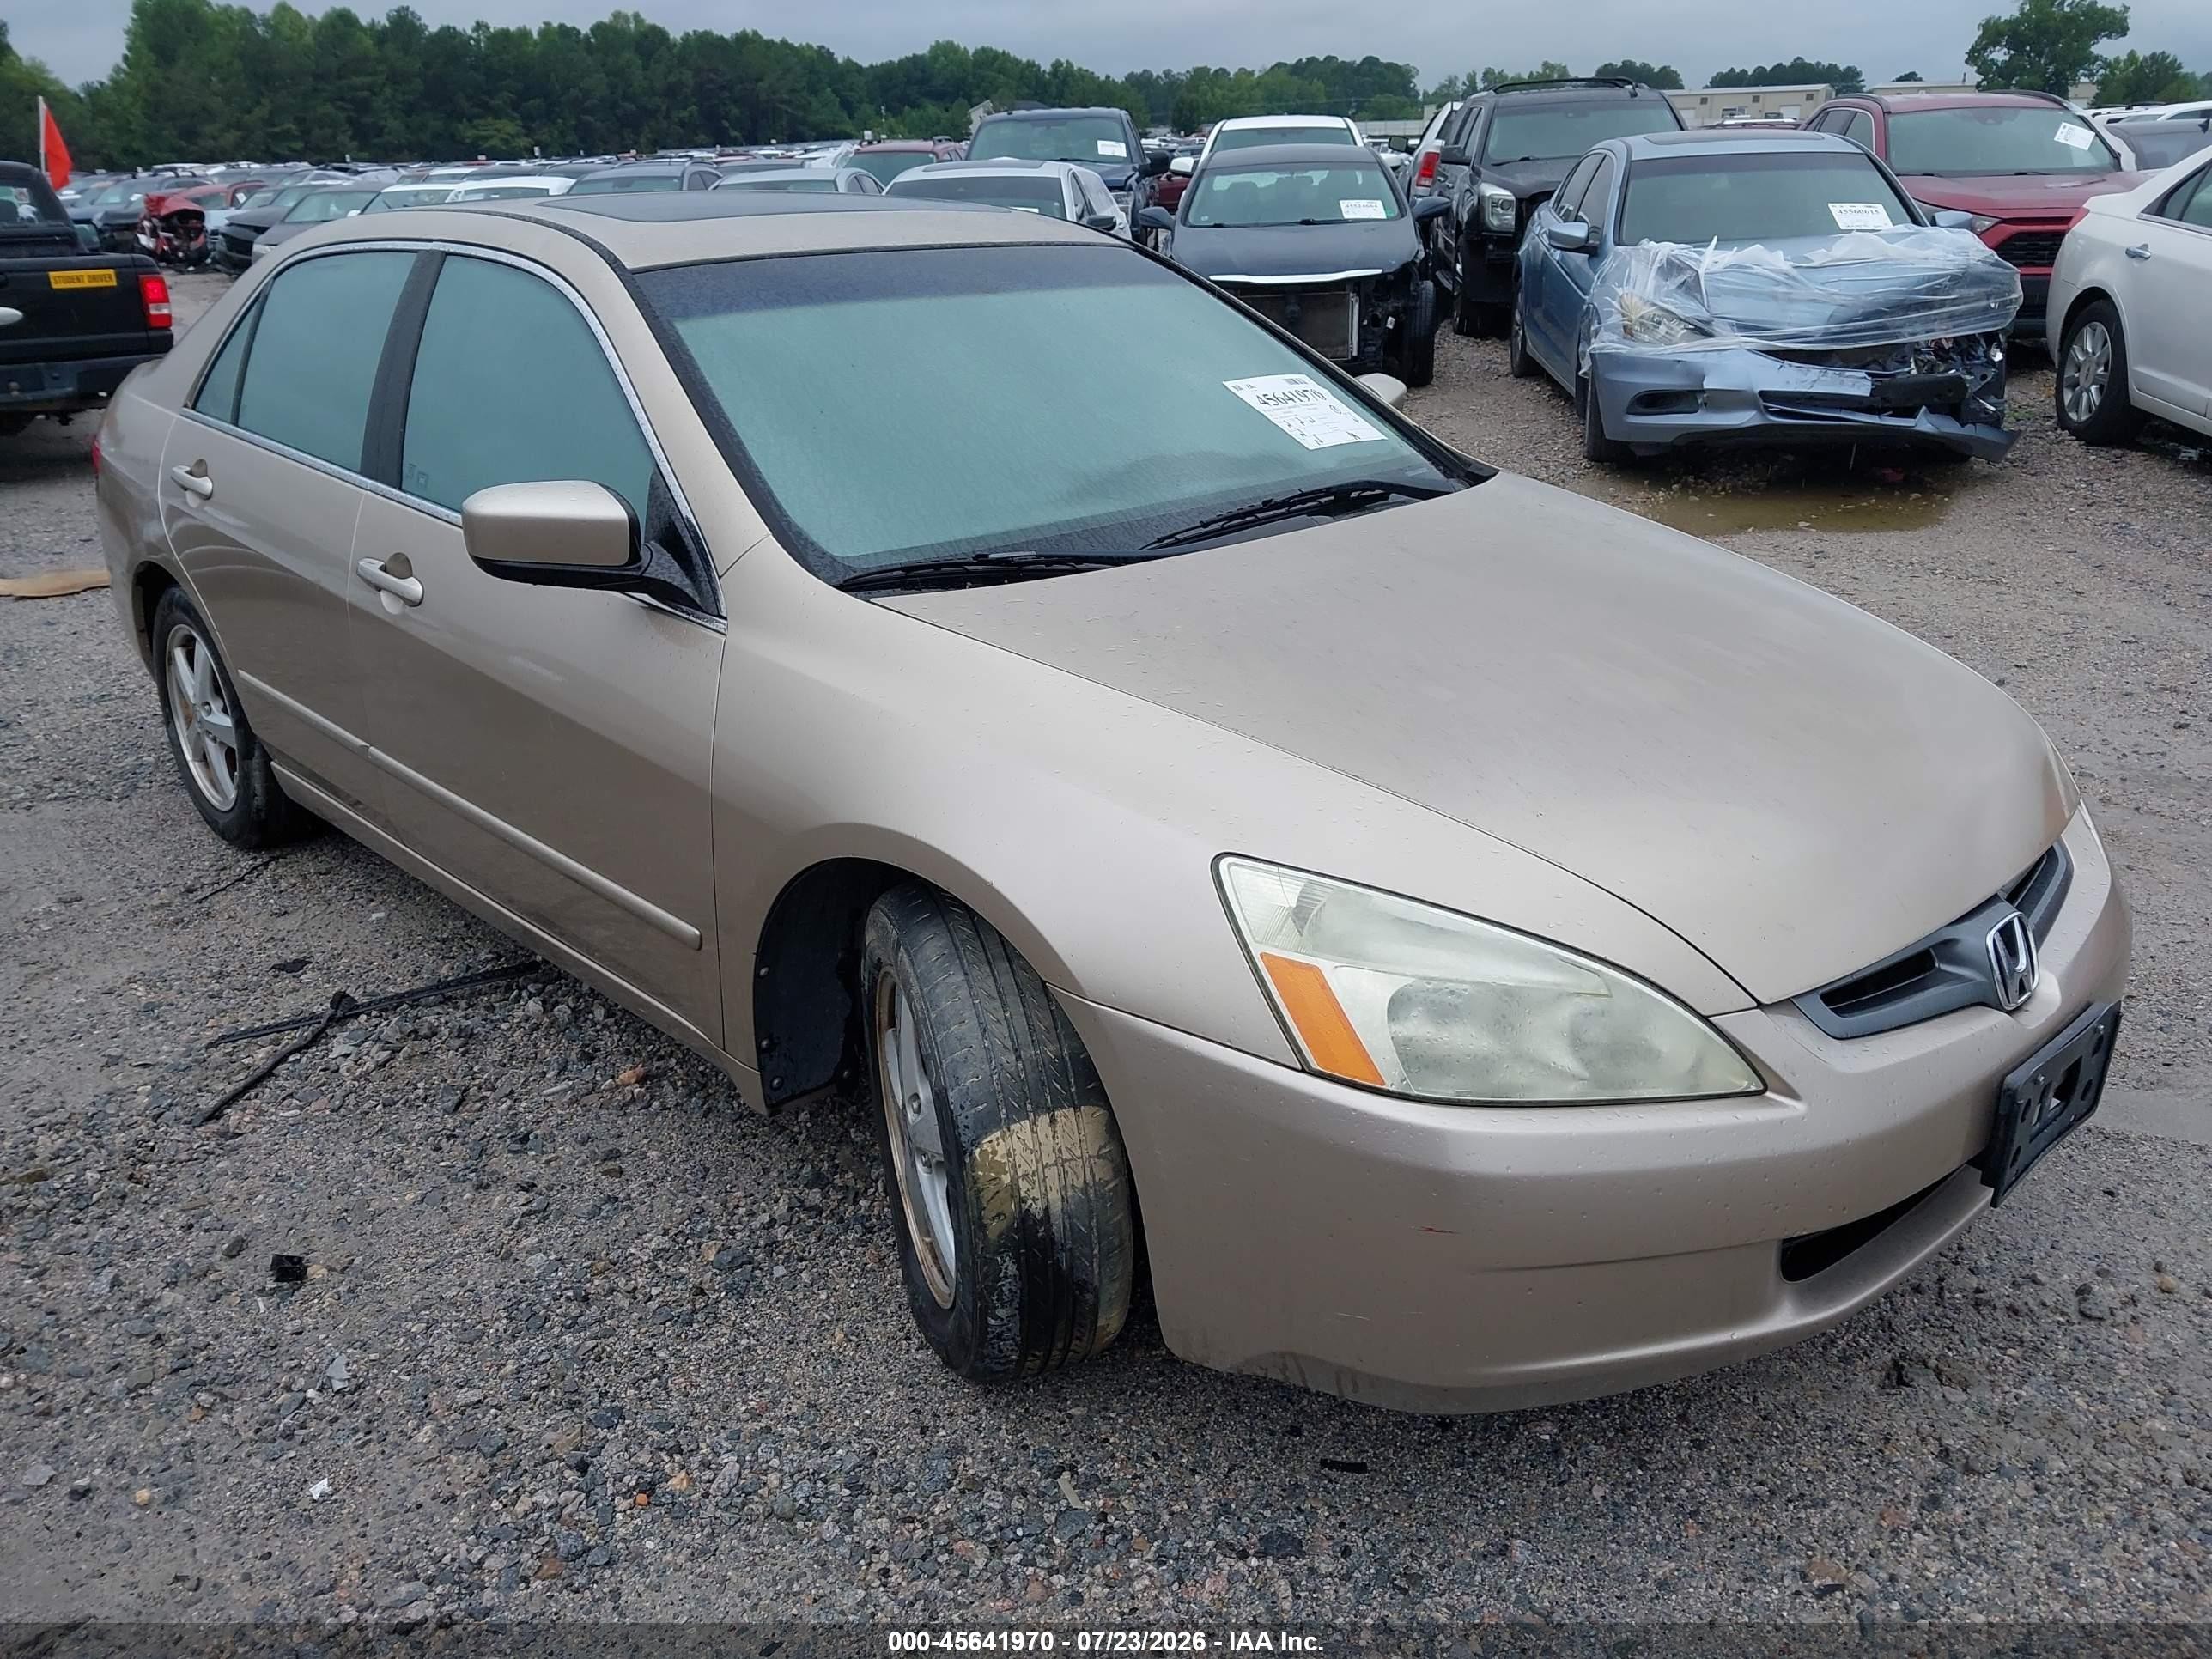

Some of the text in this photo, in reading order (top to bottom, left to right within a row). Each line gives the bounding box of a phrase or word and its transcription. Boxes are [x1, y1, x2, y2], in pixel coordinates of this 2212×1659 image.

[52, 273, 113, 285] STUDENT DRIVER
[1255, 388, 1327, 407] 45641970
